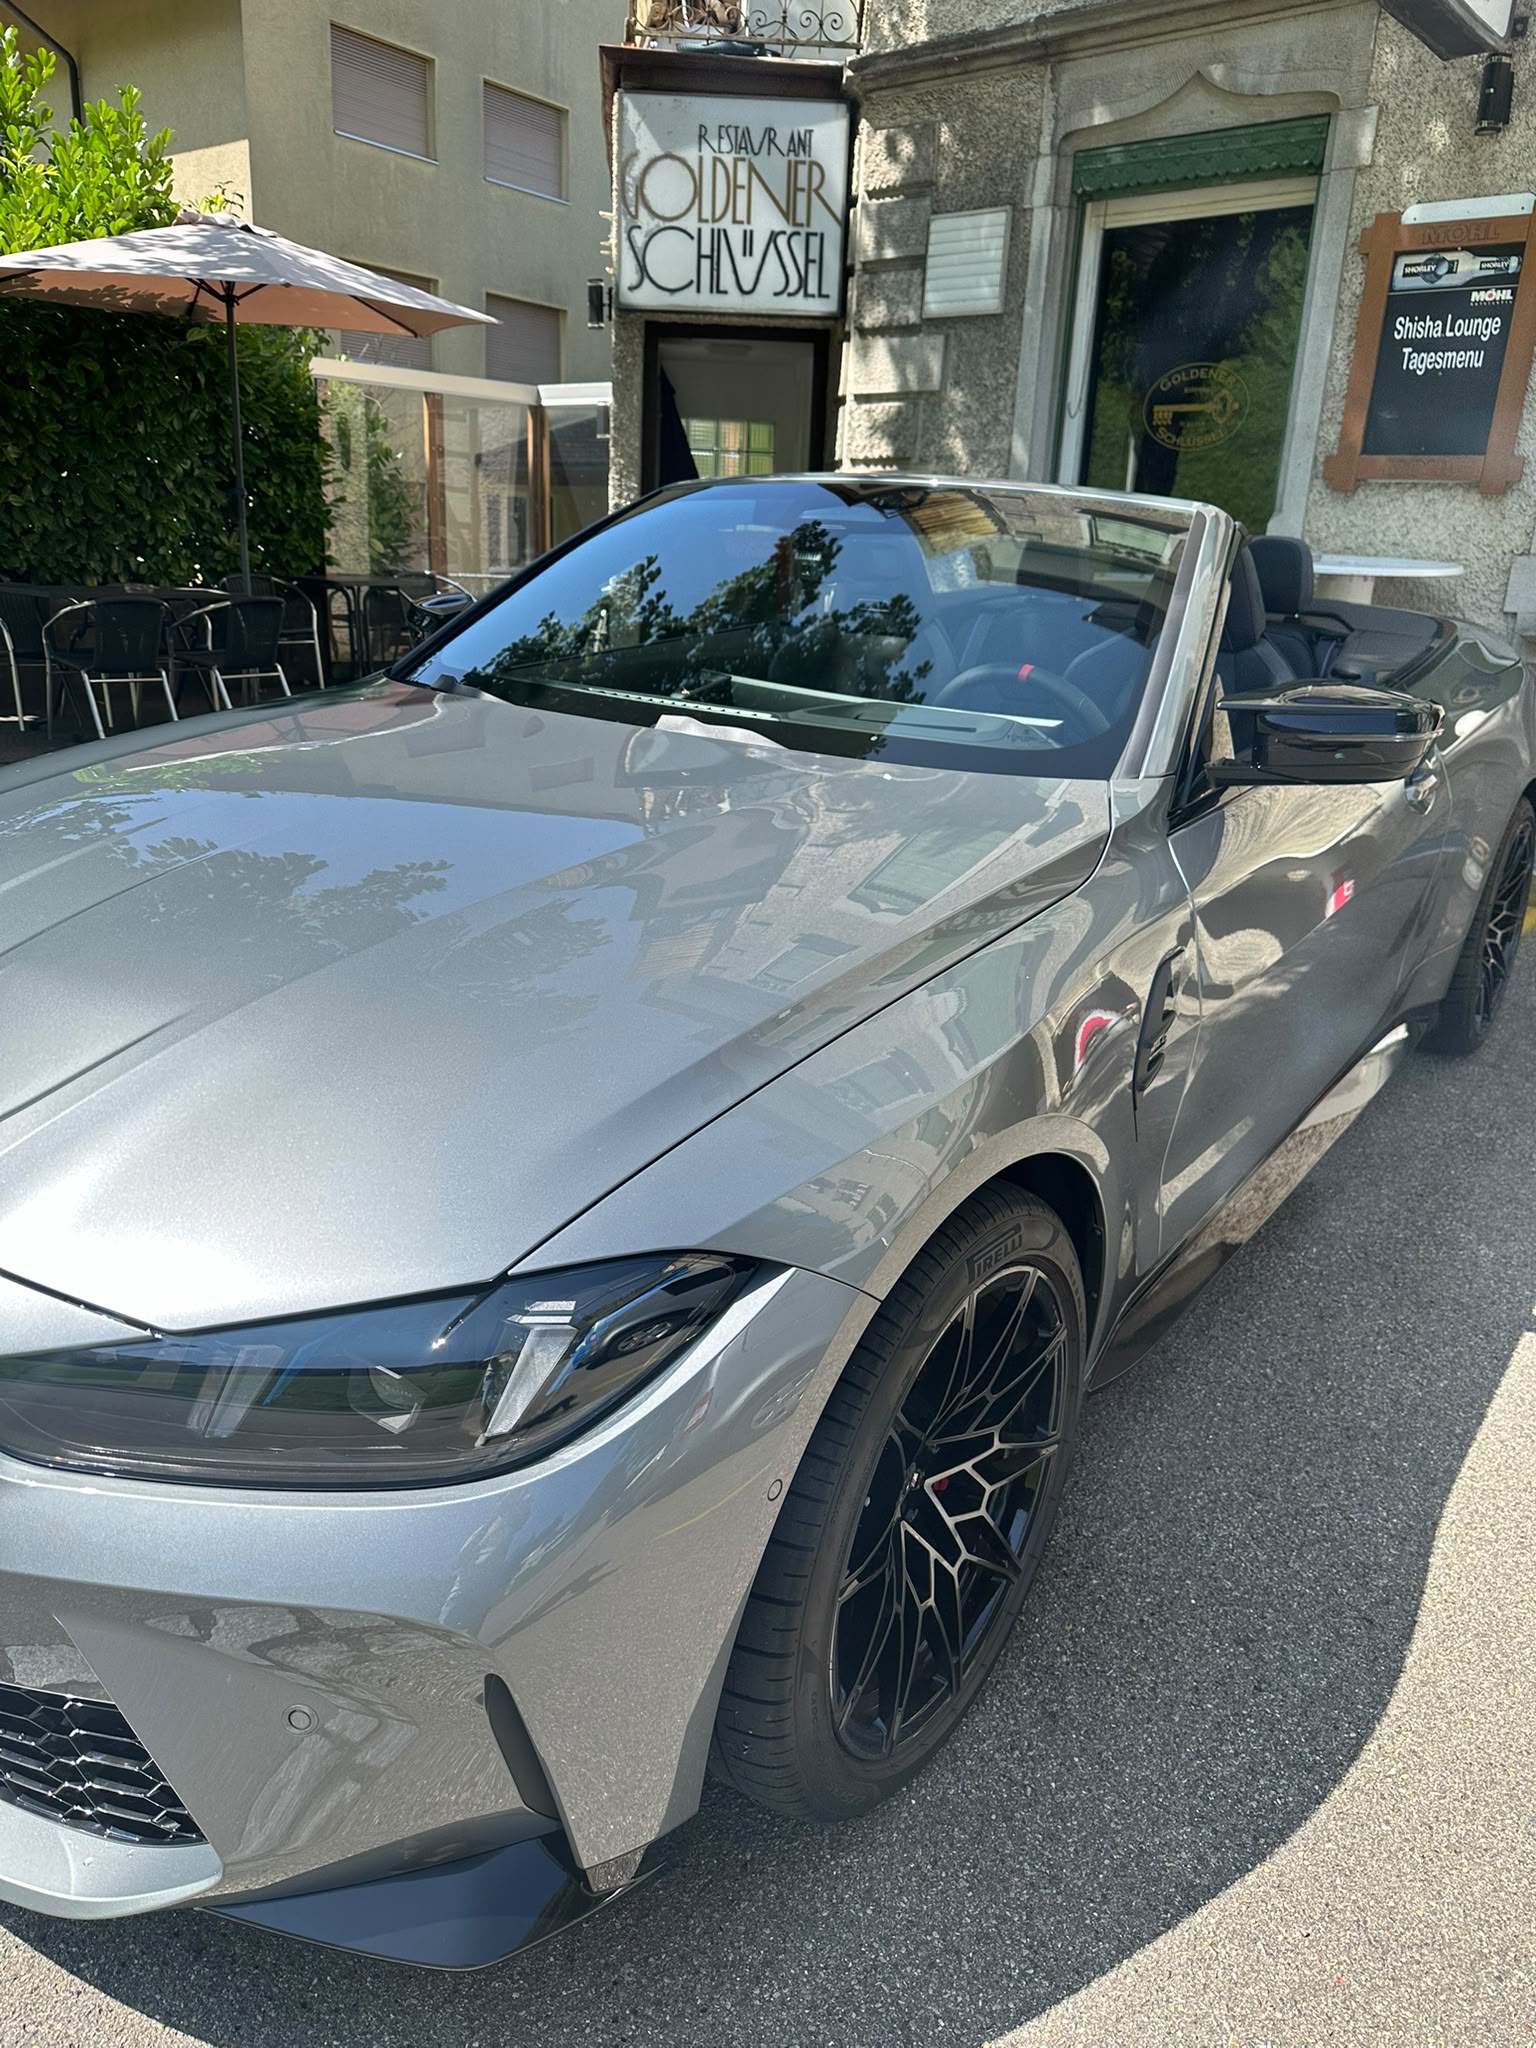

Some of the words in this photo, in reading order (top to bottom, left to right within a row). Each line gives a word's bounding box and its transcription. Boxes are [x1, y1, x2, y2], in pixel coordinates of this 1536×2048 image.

[621, 151, 842, 228] GOLDENER
[627, 225, 831, 299] SCHLÜSSEL
[1471, 288, 1513, 301] MÖHL
[1393, 314, 1442, 340] Shisha
[1445, 313, 1502, 342] Lounge
[1402, 346, 1485, 376] Tagesmenu
[1160, 368, 1236, 391] GOLDENER
[965, 1222, 1022, 1285] PIRELLI
